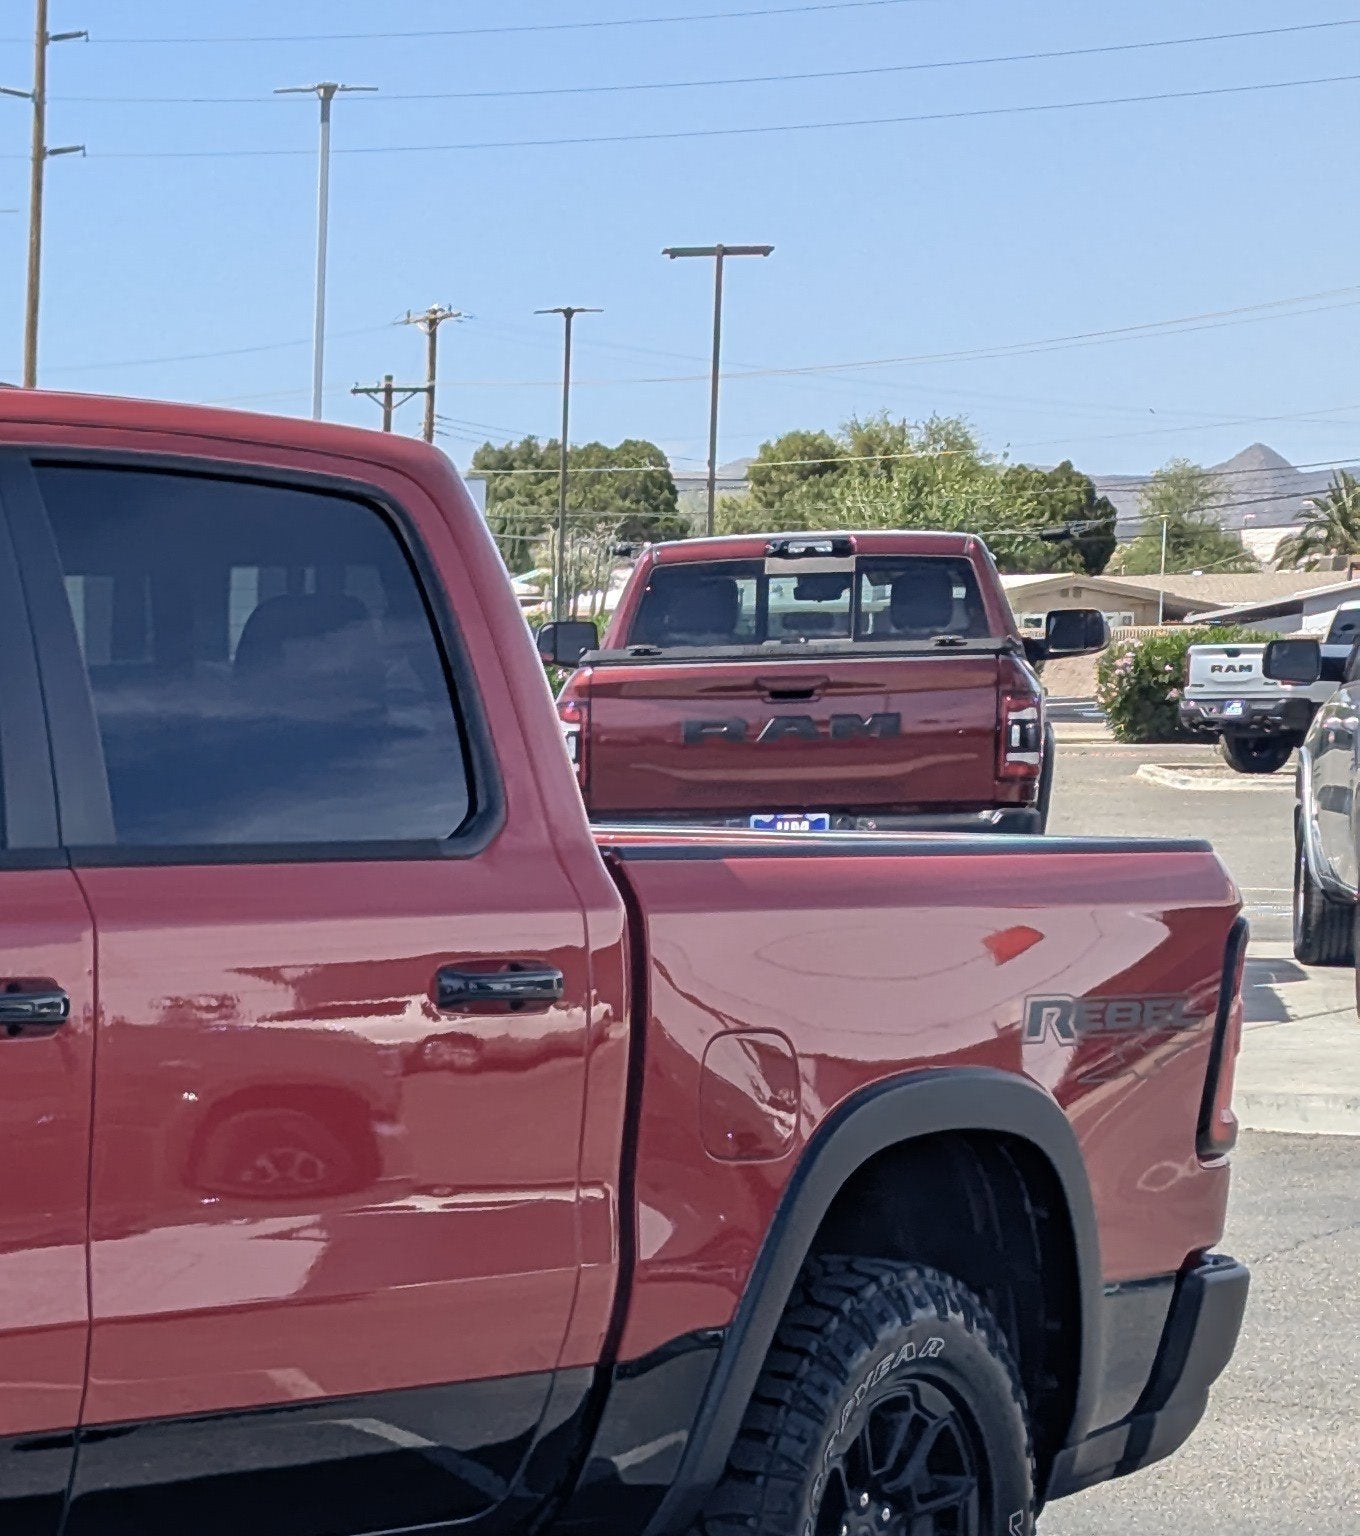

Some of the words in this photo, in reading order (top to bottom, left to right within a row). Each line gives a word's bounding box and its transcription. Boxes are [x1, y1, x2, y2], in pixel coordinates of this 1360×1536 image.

[1210, 664, 1253, 673] RAM
[683, 712, 901, 743] RAM
[1022, 993, 1206, 1046] REBEL
